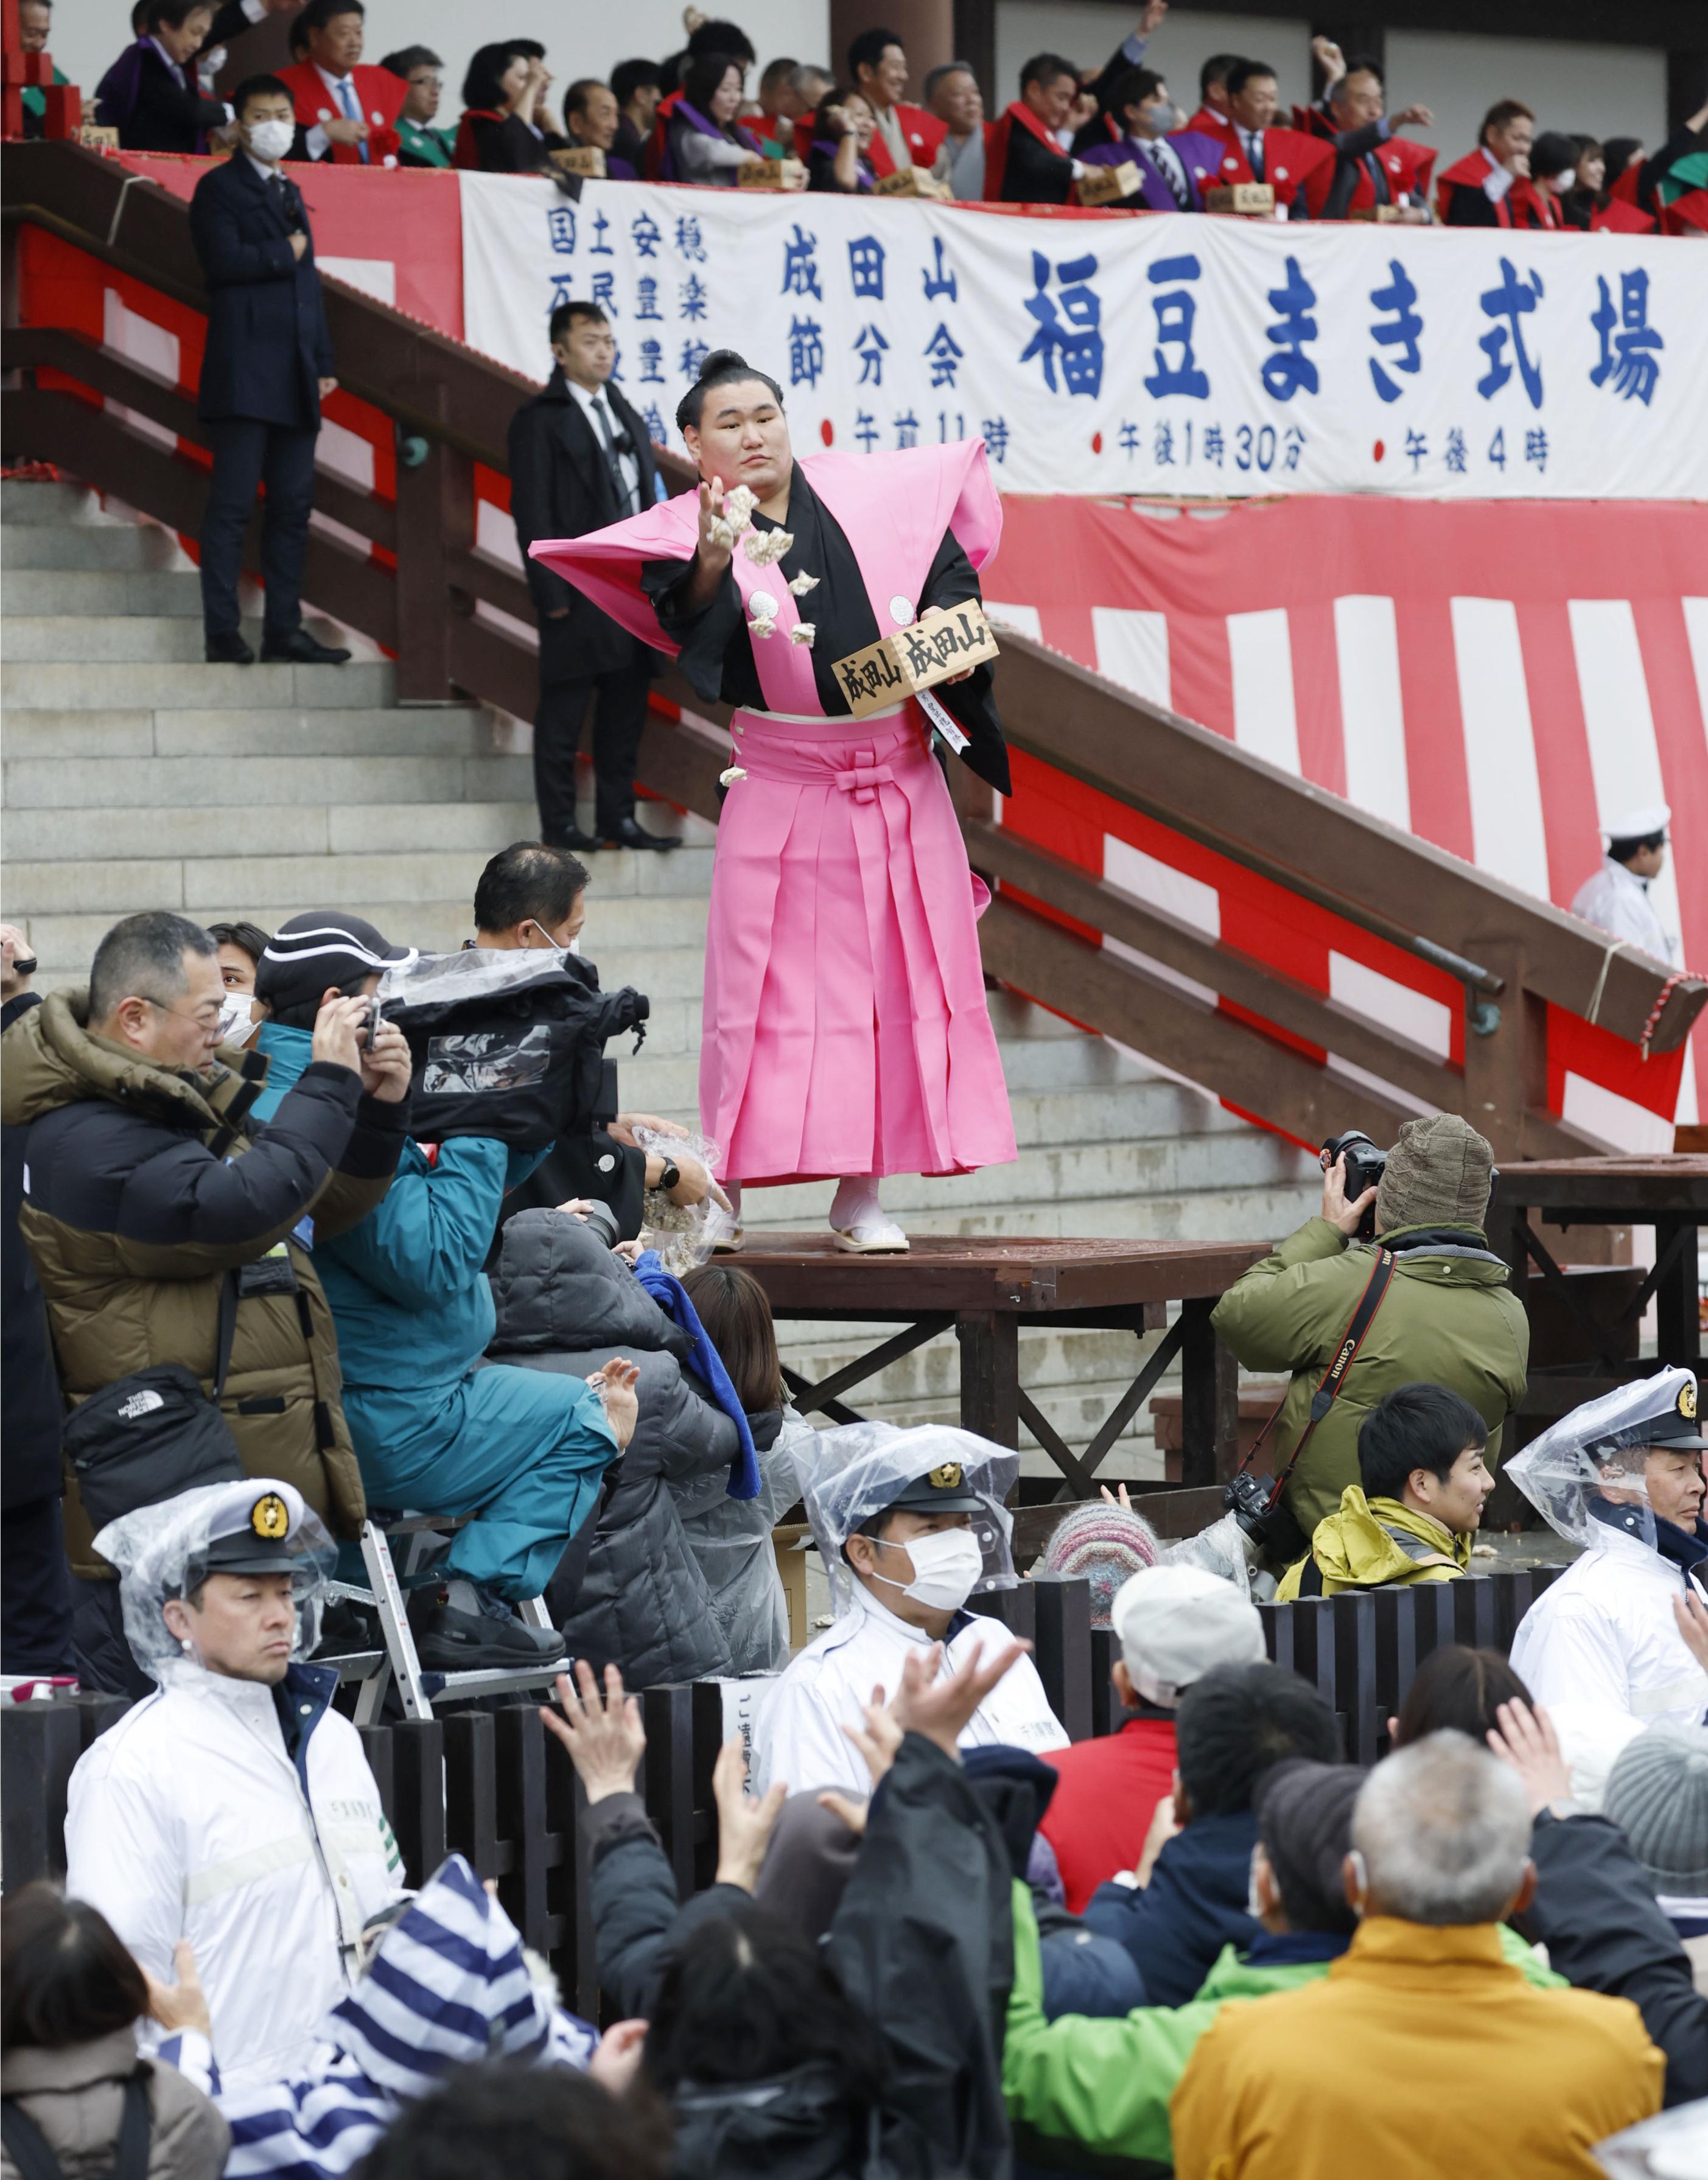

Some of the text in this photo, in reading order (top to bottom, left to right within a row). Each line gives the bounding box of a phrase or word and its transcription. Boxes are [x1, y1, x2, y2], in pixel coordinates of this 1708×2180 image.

[781, 223, 957, 302] 成田山
[788, 315, 964, 388] 節分会
[1019, 250, 1664, 409] 福豆まき式場
[1120, 420, 1306, 470] 午後1時30分
[1405, 426, 1548, 472] 午後4時
[903, 613, 985, 679] 成田山
[841, 648, 901, 703] 成田山
[1331, 1339, 1355, 1378] Canon
[117, 1399, 146, 1417] NORTH
[126, 1391, 144, 1403] THE
[128, 1405, 149, 1419] FACE
